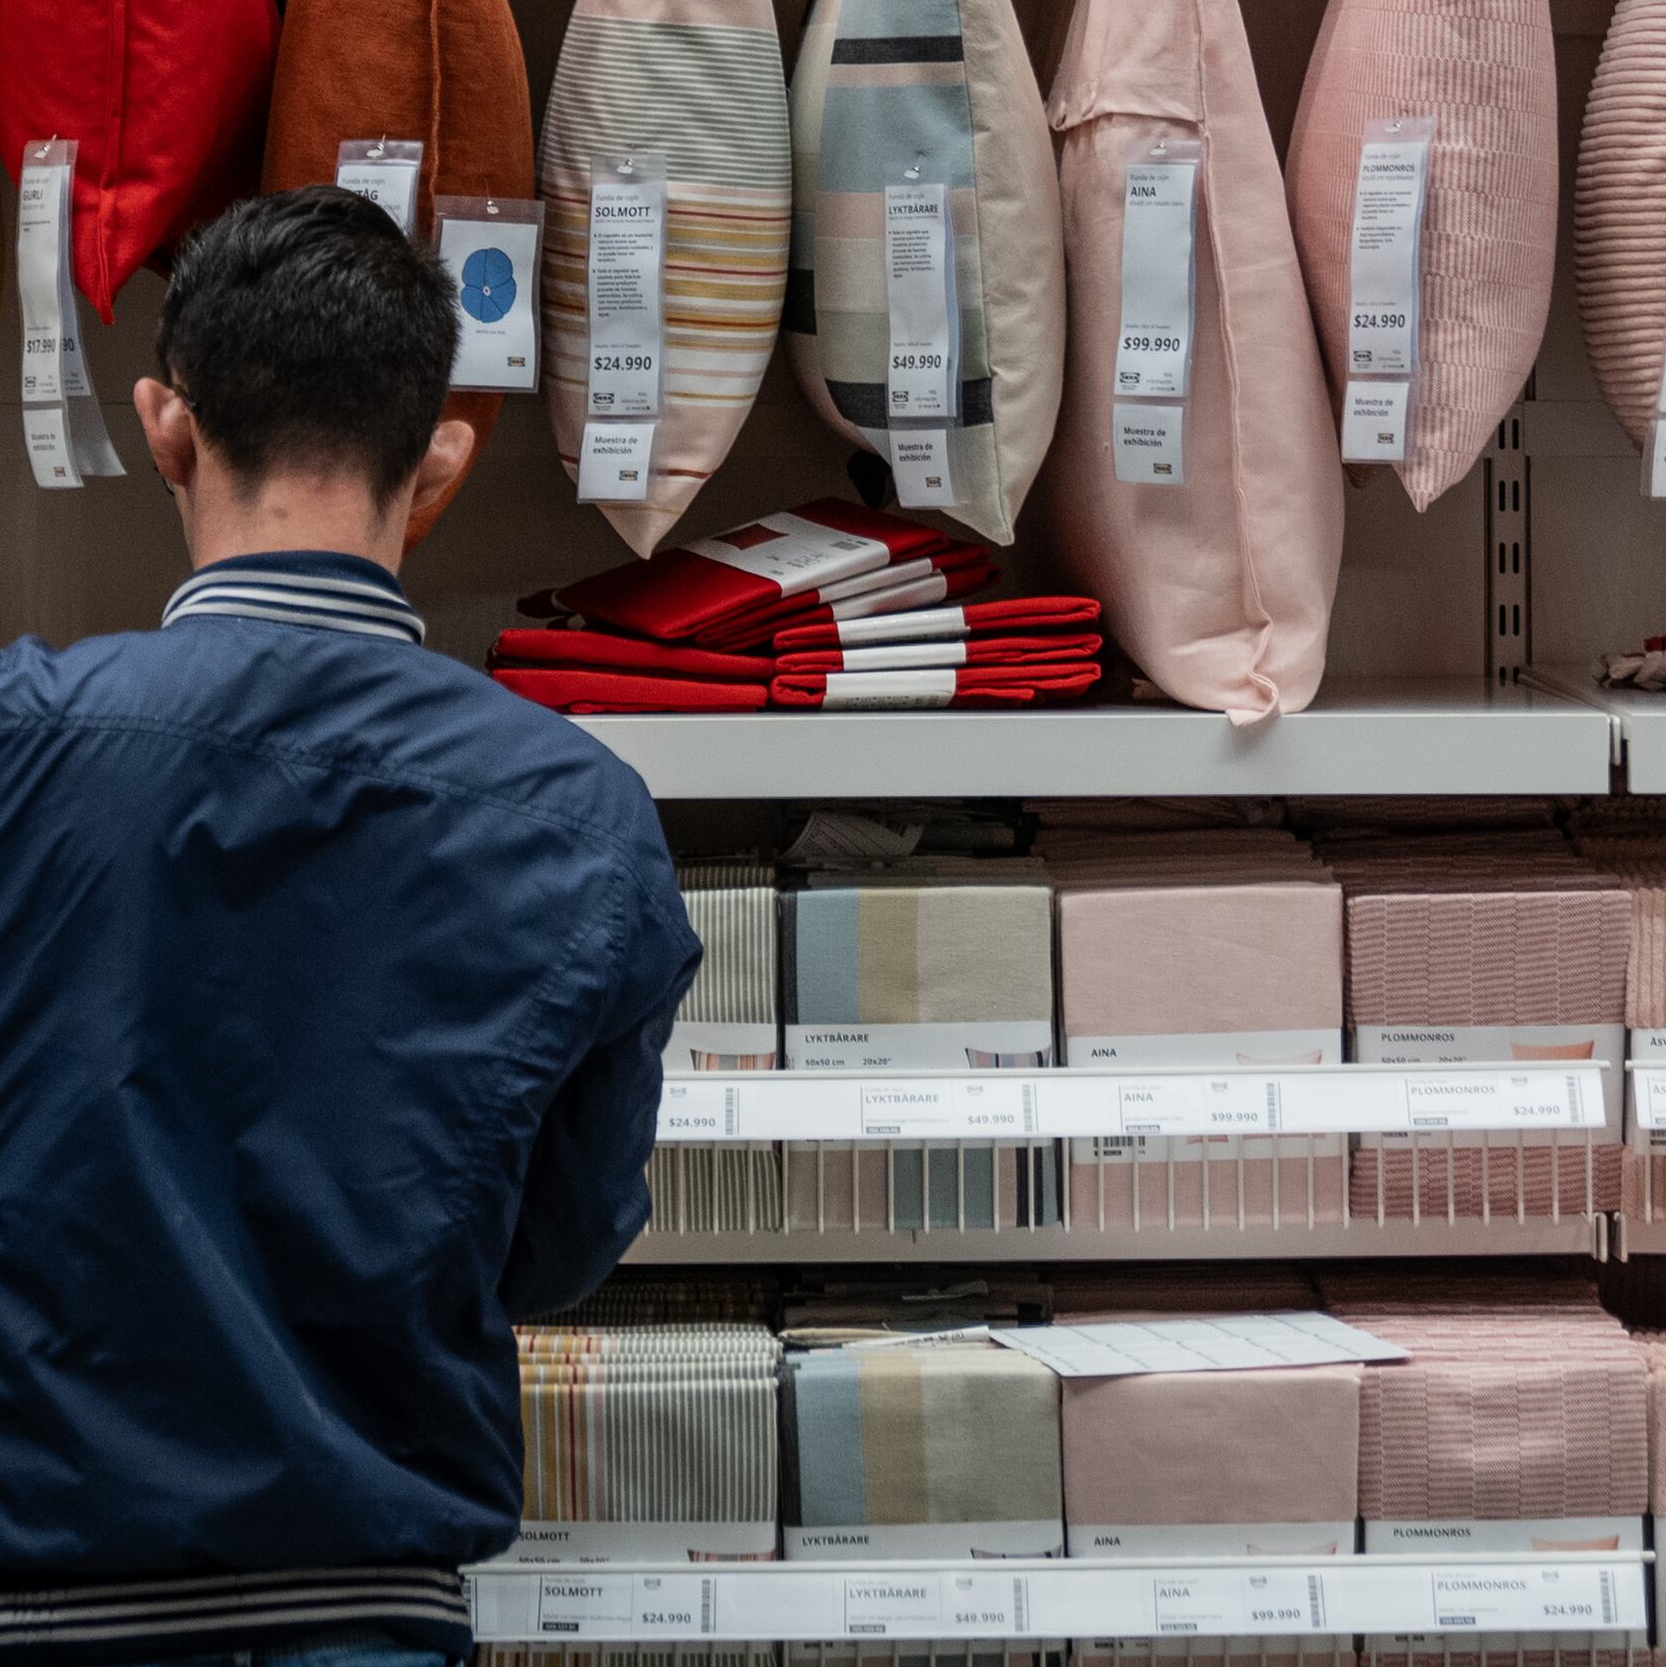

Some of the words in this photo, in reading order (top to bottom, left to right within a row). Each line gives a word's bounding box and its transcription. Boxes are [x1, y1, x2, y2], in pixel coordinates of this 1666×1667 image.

[1363, 164, 1415, 173] PLOMMONROS
[1130, 186, 1156, 197] AINA
[595, 206, 651, 218] SOLMOTT
[888, 203, 939, 215] LYKTBÄRARE
[1354, 314, 1405, 328] $24.990
[1123, 337, 1180, 352] $99.990
[594, 356, 652, 371] $24.990
[892, 355, 942, 369] $49.990
[1355, 397, 1383, 406] Muestra
[1384, 398, 1394, 407] de
[1123, 427, 1154, 436] Muestra
[1156, 428, 1166, 437] de
[594, 436, 627, 444] Muestra
[628, 436, 638, 445] de
[805, 1032, 869, 1044] LYKTBÄRARE
[1381, 1032, 1455, 1043] PLOMMONROS
[1091, 1048, 1117, 1059] AINA
[1410, 1085, 1497, 1096] PLOMMONROS
[864, 1092, 940, 1105] LYKTBÄRARE
[1123, 1092, 1154, 1104] AINA
[1513, 1104, 1561, 1117] $24.990
[668, 1116, 716, 1129] $24.990
[967, 1113, 1015, 1126] $49.990
[1210, 1111, 1258, 1123] $99.990
[518, 1531, 570, 1542] SOLMOTT
[1393, 1527, 1472, 1538] PLOMMONROS
[802, 1534, 870, 1547] LYKTBÄRARE
[1093, 1536, 1122, 1547] AINA
[1436, 1580, 1527, 1592] PLOMMONROS
[544, 1587, 604, 1598] SOLMOTT
[849, 1586, 927, 1599] LYKTBÄRARE
[1159, 1587, 1191, 1599] AINA
[1251, 1608, 1301, 1621] $99.990
[1543, 1603, 1593, 1616] $24.990
[641, 1612, 691, 1624] $24.990
[955, 1612, 1005, 1624] $49.990
